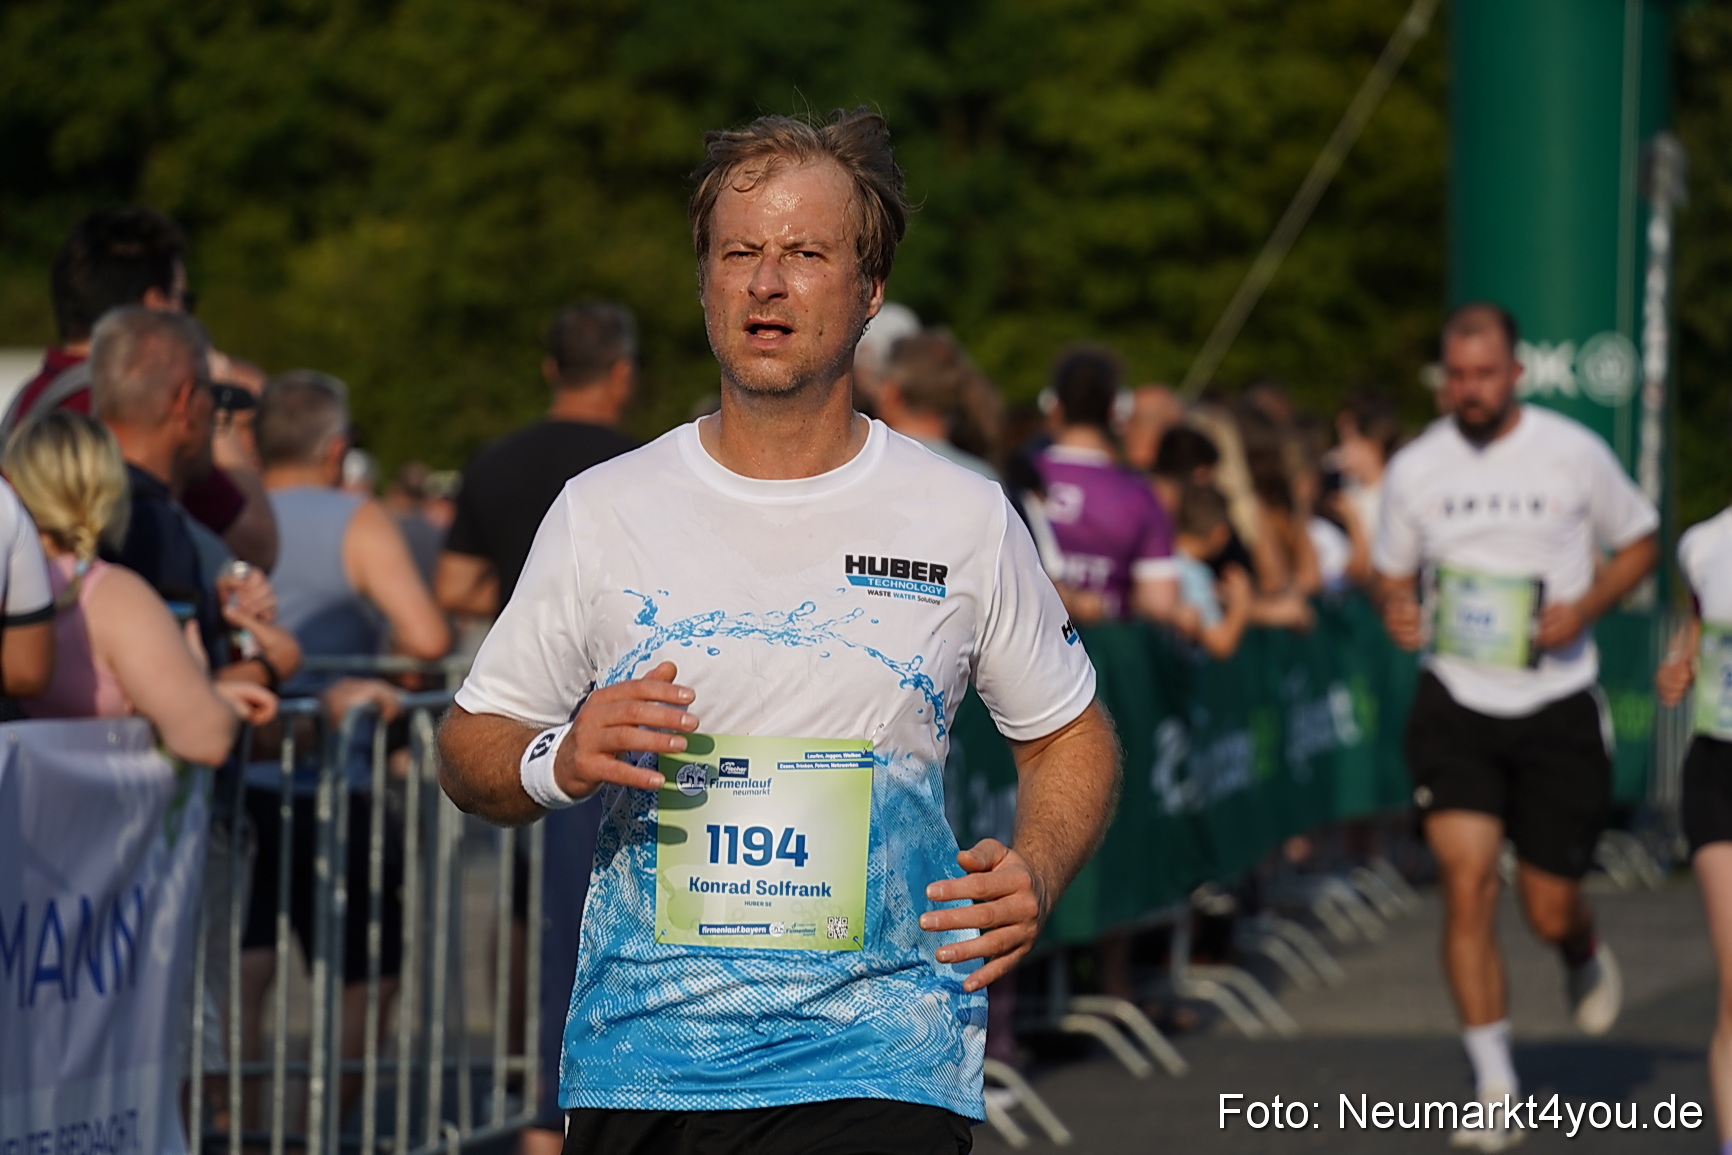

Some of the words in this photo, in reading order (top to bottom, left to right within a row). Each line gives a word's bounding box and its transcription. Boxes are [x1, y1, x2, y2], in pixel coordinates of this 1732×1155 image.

[845, 554, 948, 585] HUBER
[867, 577, 943, 596] TECHNOLOGY
[867, 589, 892, 598] WASTE
[893, 592, 916, 601] WATER
[917, 595, 941, 605] Solutions
[709, 777, 772, 789] Firmenlauf
[732, 788, 770, 796] neumarkt
[706, 824, 809, 868] 1194
[689, 877, 751, 895] Konrad
[755, 879, 832, 898] Solfrank
[701, 925, 767, 936] firmenlauf.bayern
